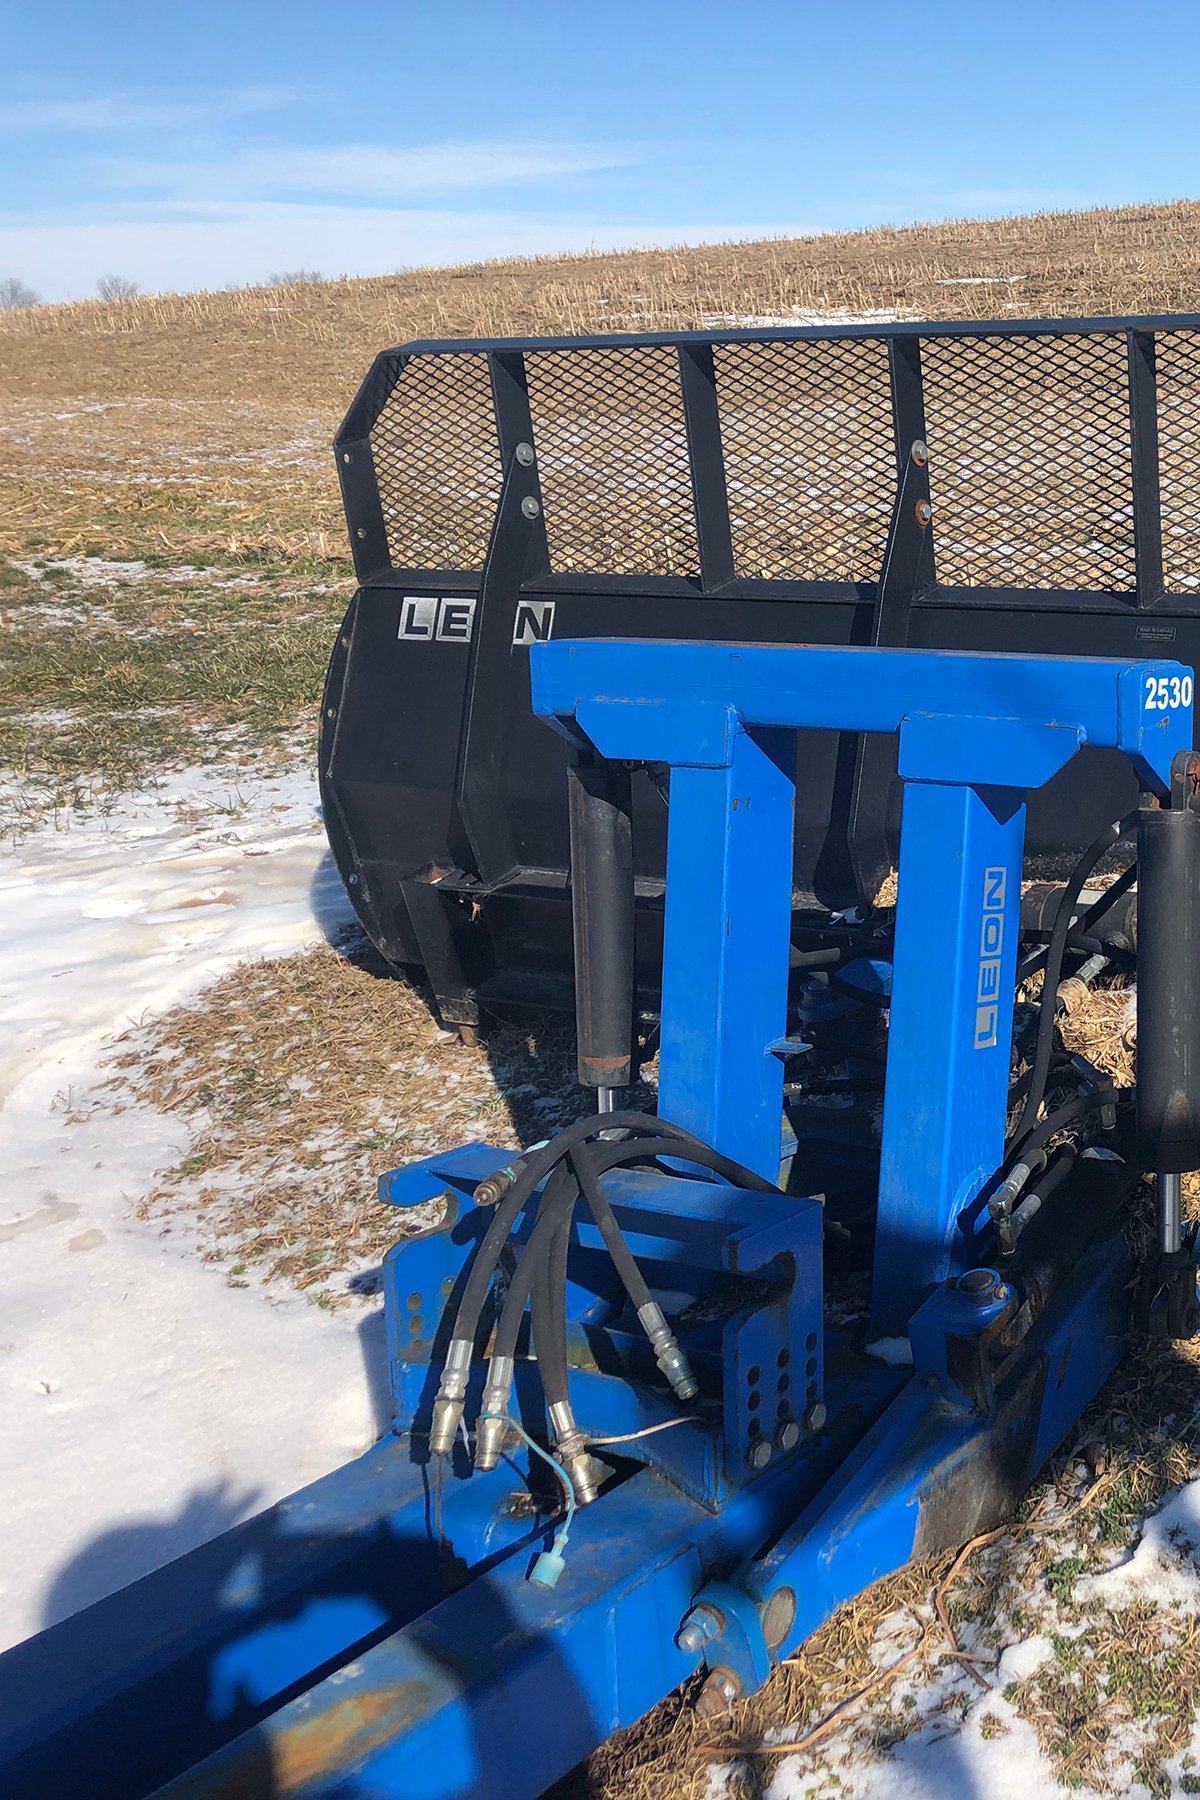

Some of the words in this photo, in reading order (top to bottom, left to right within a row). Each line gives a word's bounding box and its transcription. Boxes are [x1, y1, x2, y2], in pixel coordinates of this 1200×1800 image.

[398, 597, 555, 644] LEN
[1145, 676, 1192, 709] 2530
[974, 867, 1007, 1049] LEON
